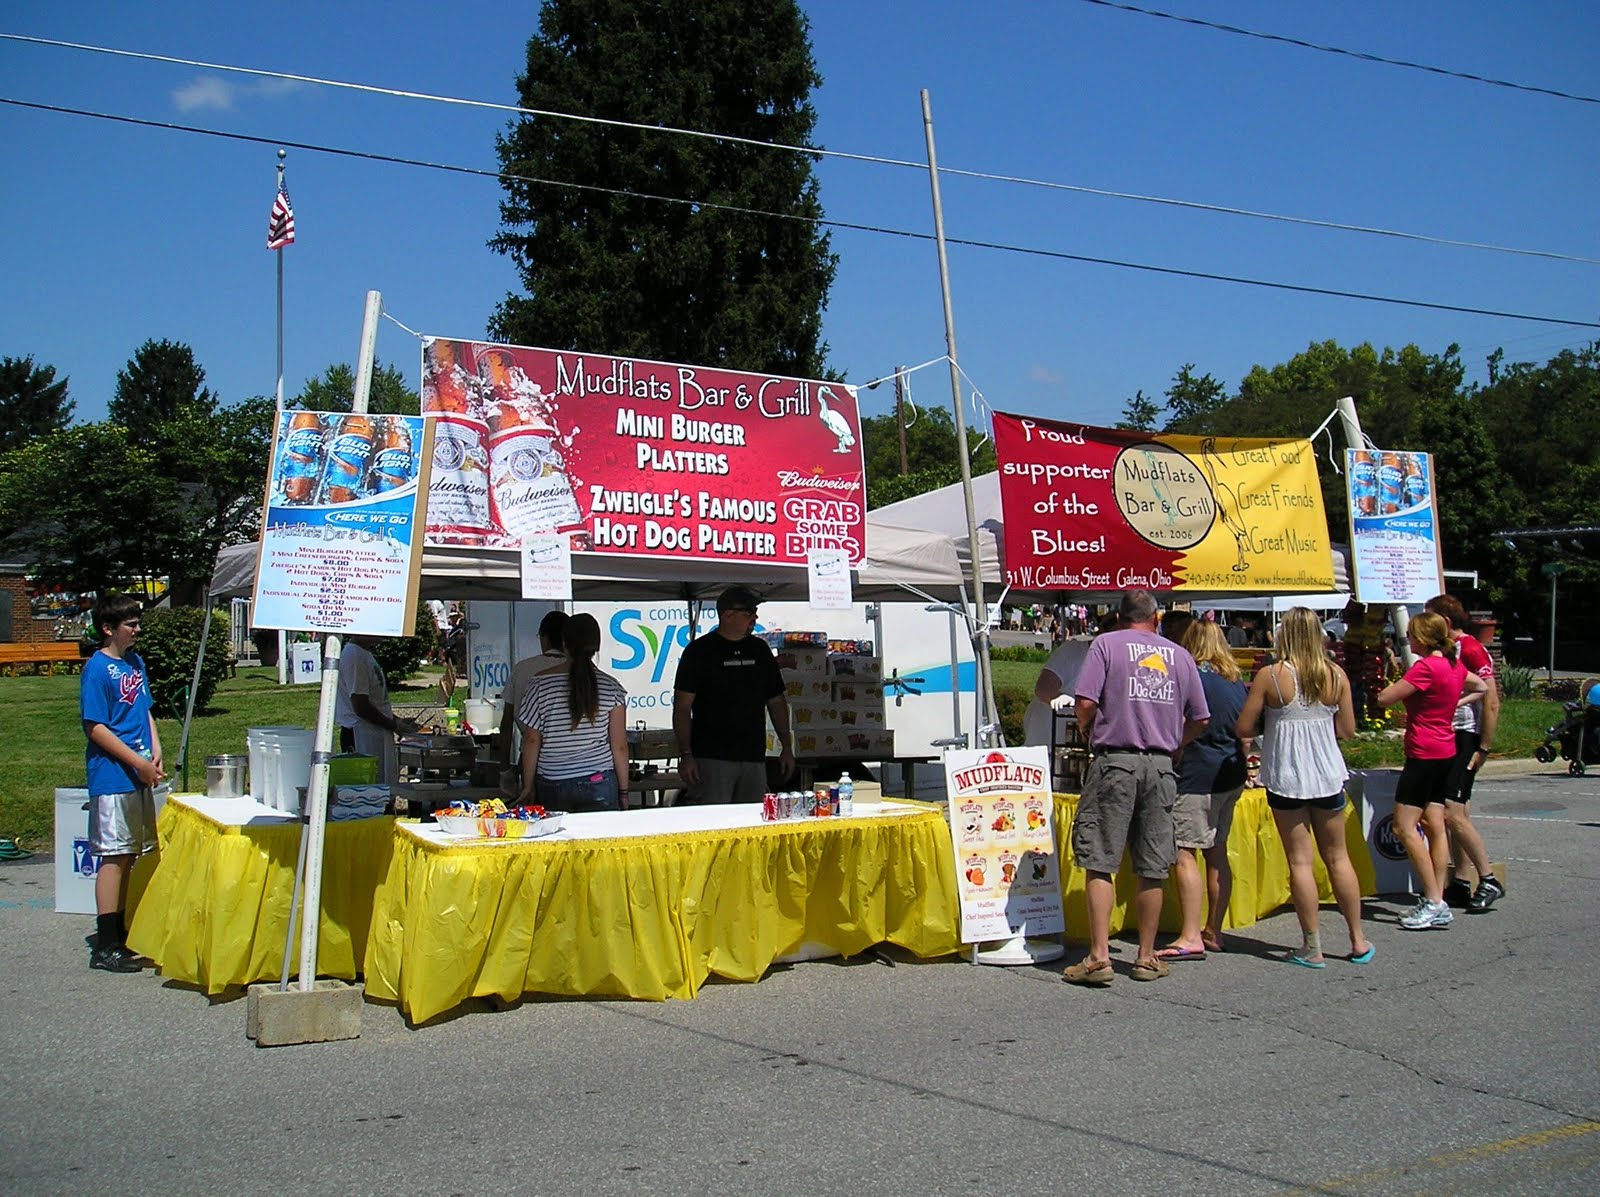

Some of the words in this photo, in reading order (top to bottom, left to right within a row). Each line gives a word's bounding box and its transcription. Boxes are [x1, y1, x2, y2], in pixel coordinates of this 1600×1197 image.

[555, 354, 671, 400] Mudflats
[678, 368, 730, 409] Bar
[735, 384, 752, 409] &
[759, 379, 811, 418] Grill
[616, 407, 664, 439] MINI
[671, 413, 746, 446] BURGER
[1021, 420, 1086, 445] Proud
[339, 437, 371, 451] BUD
[381, 452, 409, 461] BUD
[1231, 439, 1269, 466] Great
[1269, 441, 1301, 466] Food
[374, 460, 410, 469] LIGHT
[637, 442, 730, 474] PLATTERS
[1122, 458, 1195, 483] Mudflats
[777, 470, 860, 491] Budweiser
[1003, 462, 1110, 485] supporter
[430, 477, 486, 496] dweiser
[496, 483, 571, 509] Budweiser
[1237, 482, 1272, 510] Great
[1271, 484, 1314, 511] Friends
[698, 491, 778, 523] FAMOUS
[784, 498, 860, 525] GRAB
[1033, 492, 1059, 514] of
[1063, 492, 1099, 515] the
[1125, 491, 1155, 514] Bar
[1161, 499, 1171, 513] &
[1176, 494, 1211, 517] Grill
[335, 513, 367, 522] HERE
[371, 514, 388, 523] WE
[389, 515, 408, 525] GO
[797, 520, 849, 538] SOME
[593, 517, 638, 546] HOT
[645, 520, 692, 550] DOG
[698, 524, 777, 556] PLATTER
[1031, 529, 1106, 555] Blues!
[1149, 530, 1167, 539] est.
[1170, 530, 1193, 540] 2006
[1250, 526, 1284, 554] Great
[1285, 528, 1318, 555] Music
[1020, 566, 1034, 587] W.
[1035, 566, 1080, 588] Columbus
[1080, 567, 1110, 588] Street
[1116, 567, 1149, 588] Galena,
[1150, 567, 1171, 588] Ohio
[1126, 643, 1146, 661] THE
[474, 655, 509, 691] Sysco
[1129, 676, 1148, 698] DOG
[1148, 680, 1175, 701] CAFE
[955, 765, 1042, 790] MUDFLATS
